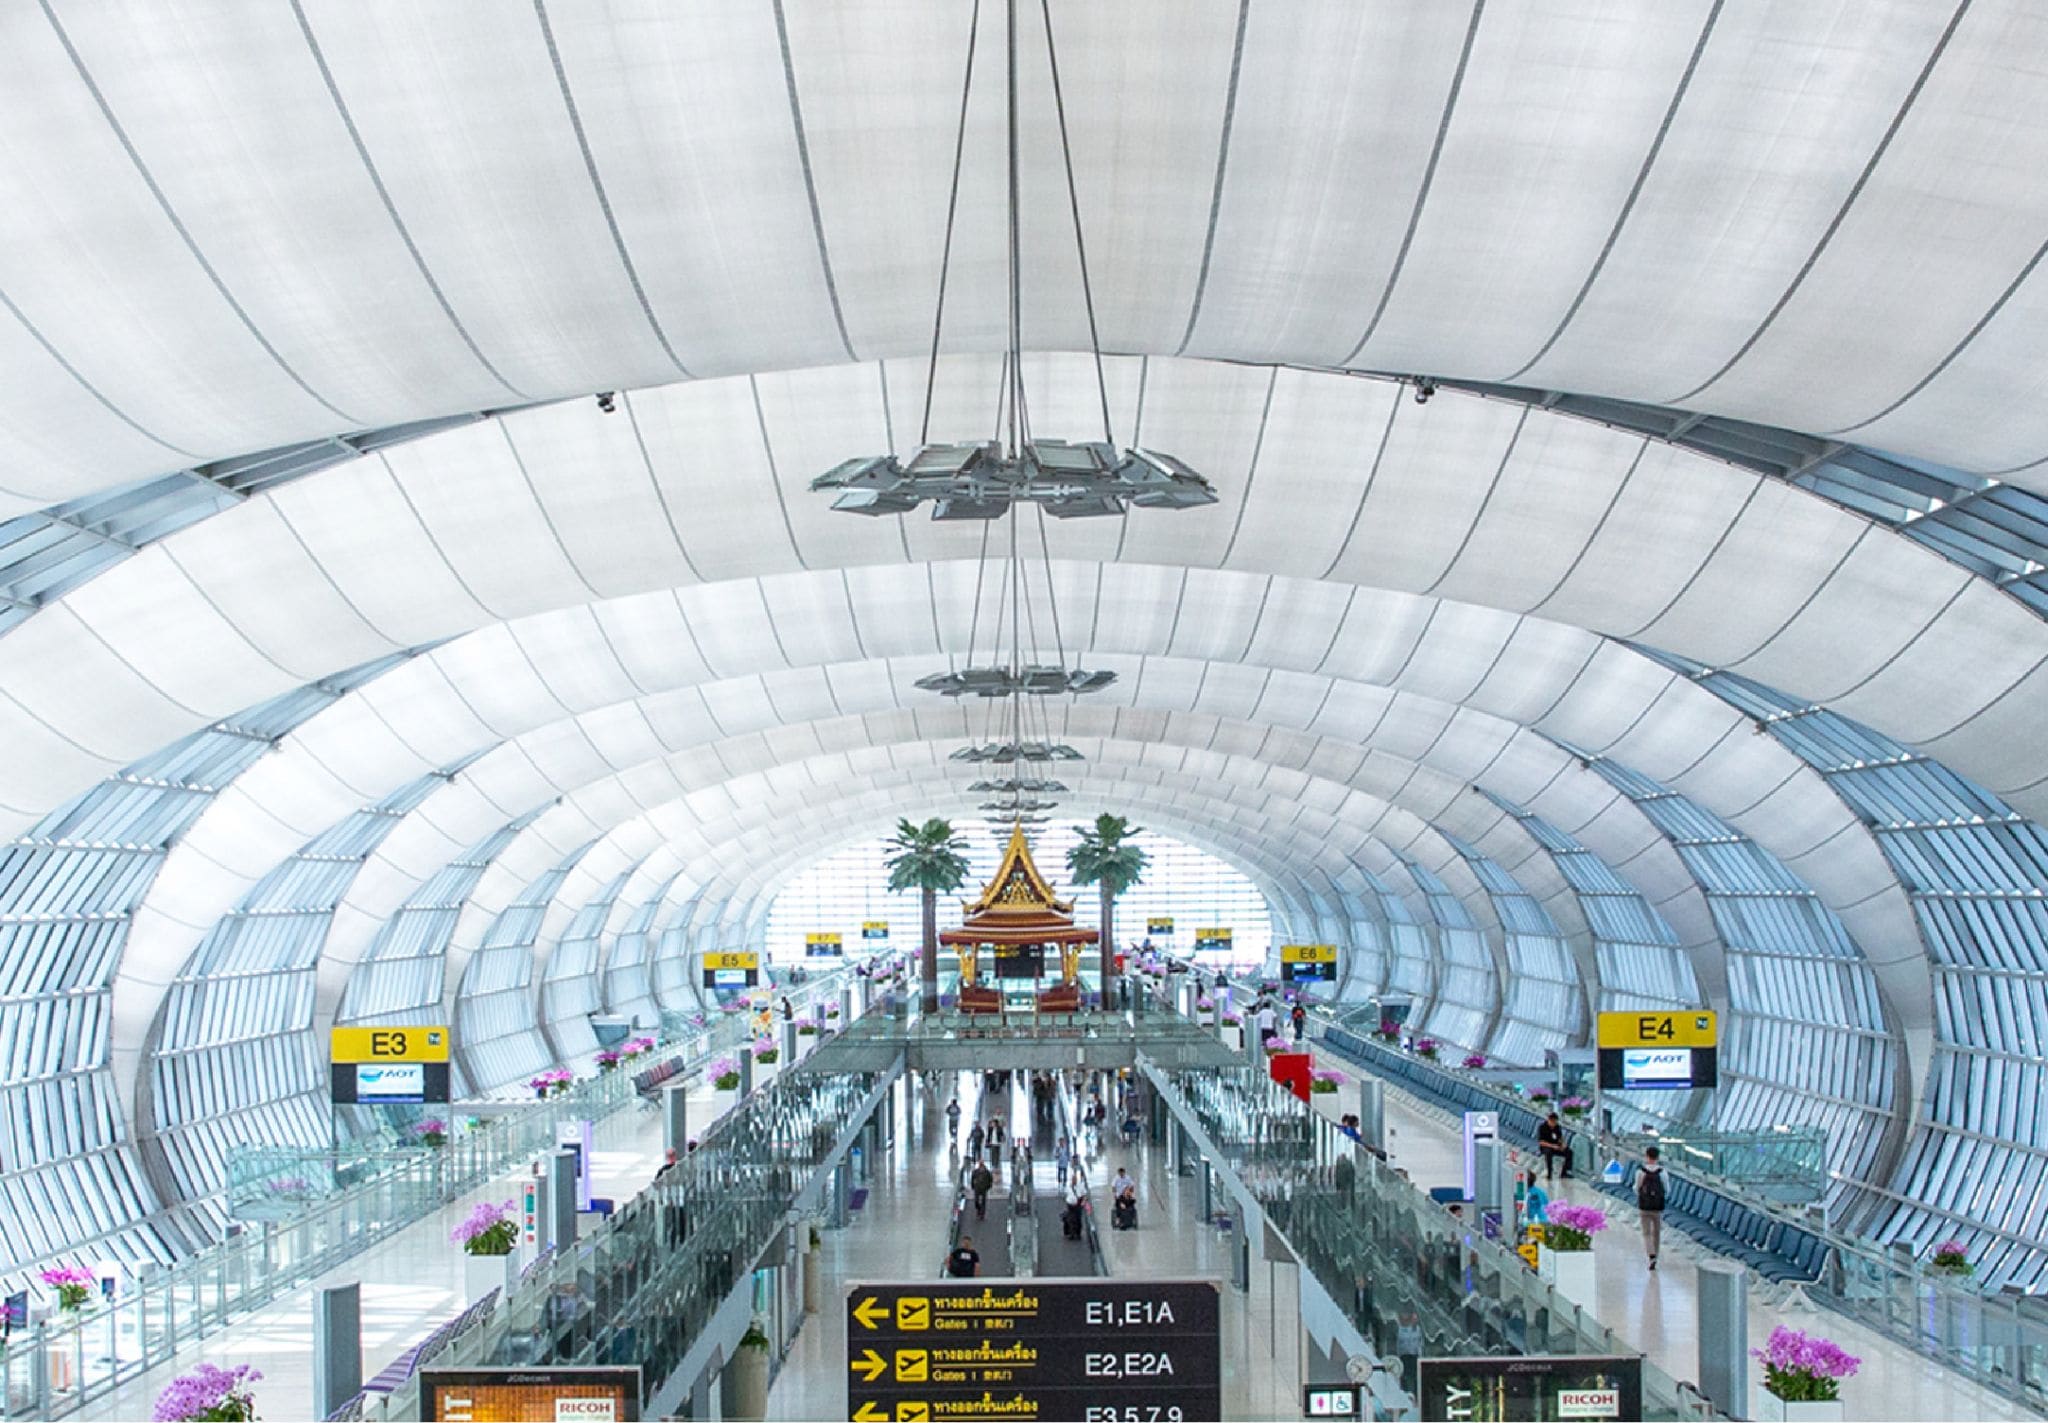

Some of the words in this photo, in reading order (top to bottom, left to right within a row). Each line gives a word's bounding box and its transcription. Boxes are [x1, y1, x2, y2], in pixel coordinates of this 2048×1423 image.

[721, 953, 739, 967] E5
[1300, 947, 1317, 959] E6
[1639, 1016, 1675, 1040] E4
[371, 1032, 407, 1056] E3
[1086, 1301, 1175, 1327] E1,E1A
[934, 1318, 968, 1330] Gates
[1085, 1353, 1174, 1379] E2,E2A
[1562, 1394, 1614, 1405] RICOH
[559, 1402, 611, 1413] RICOH
